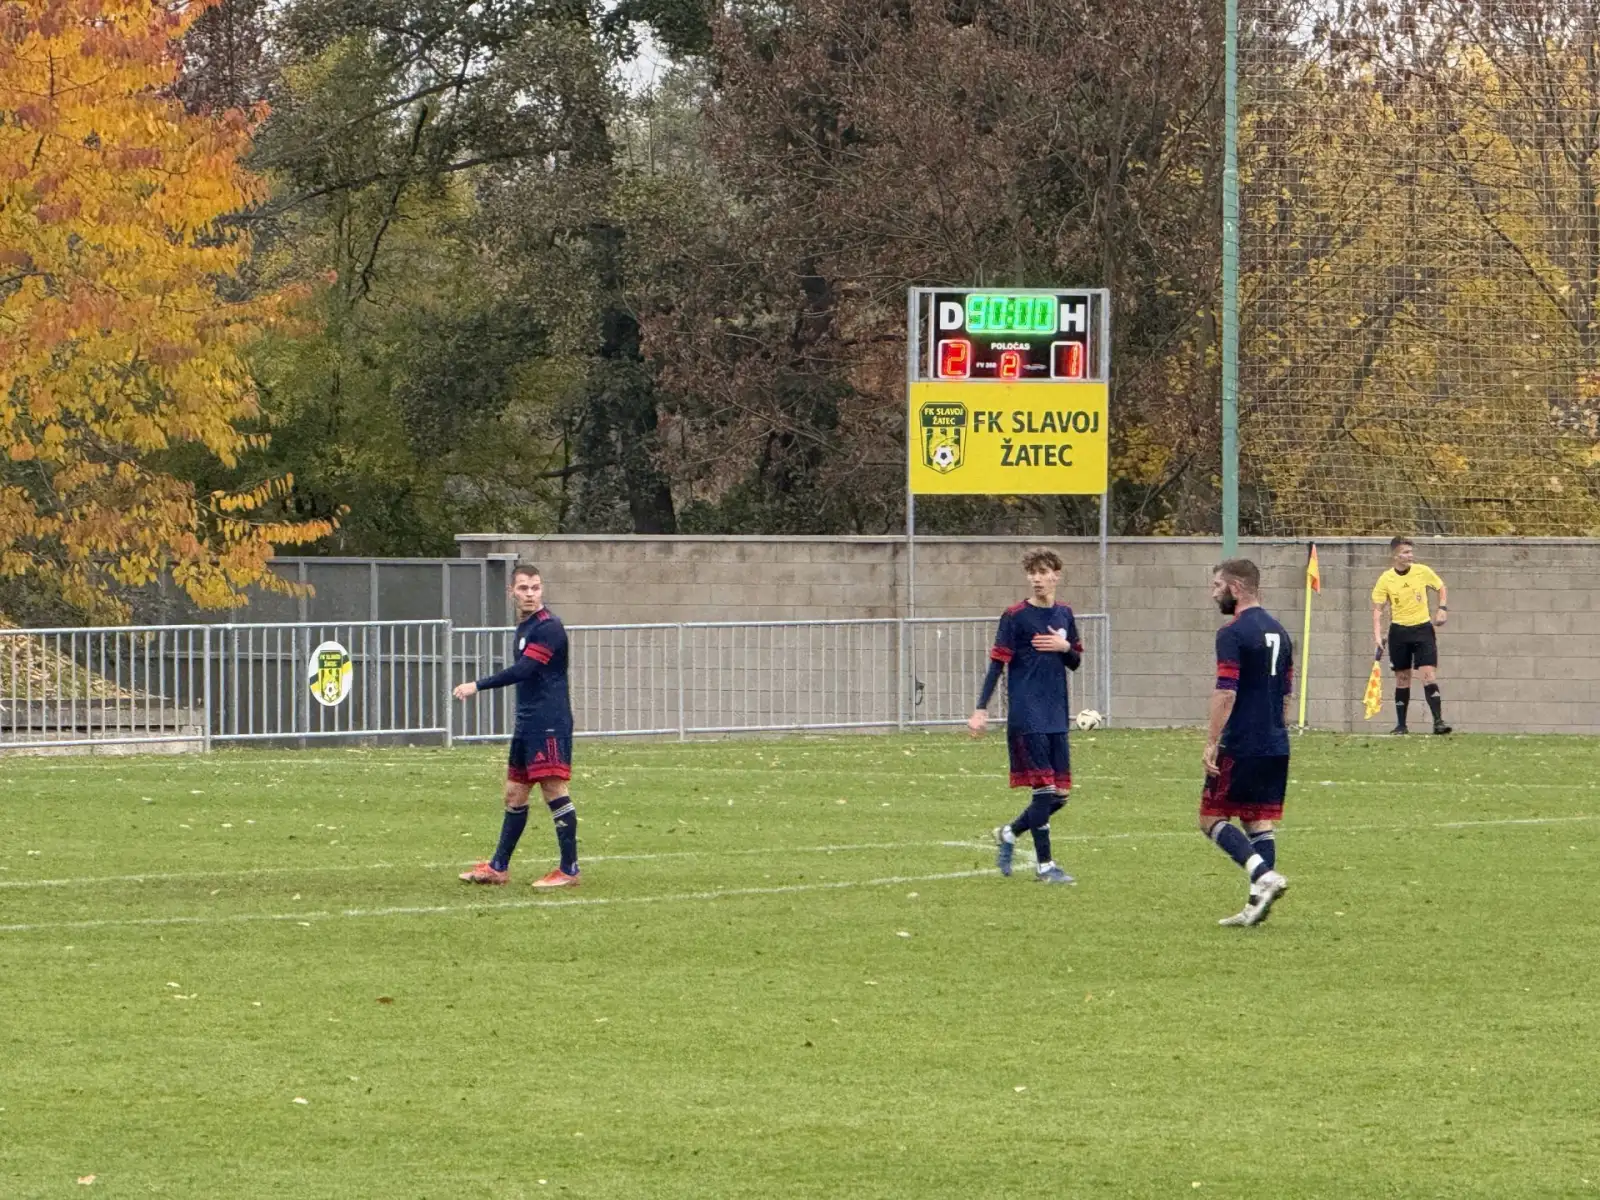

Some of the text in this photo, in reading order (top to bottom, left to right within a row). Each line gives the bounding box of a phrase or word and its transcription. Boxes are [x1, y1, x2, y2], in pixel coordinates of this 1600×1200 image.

[940, 295, 1085, 332] D 90:00 H
[946, 342, 966, 375] 2
[991, 342, 1031, 351] POLOČAS
[1069, 343, 1080, 376] 1
[1002, 354, 1017, 377] 2
[924, 407, 964, 416] FK SLAVOJ
[932, 415, 956, 425] ŽATEC
[973, 410, 1099, 434] FK SLAVOJ
[1000, 437, 1073, 467] ŽATEC
[1264, 632, 1281, 676] 7
